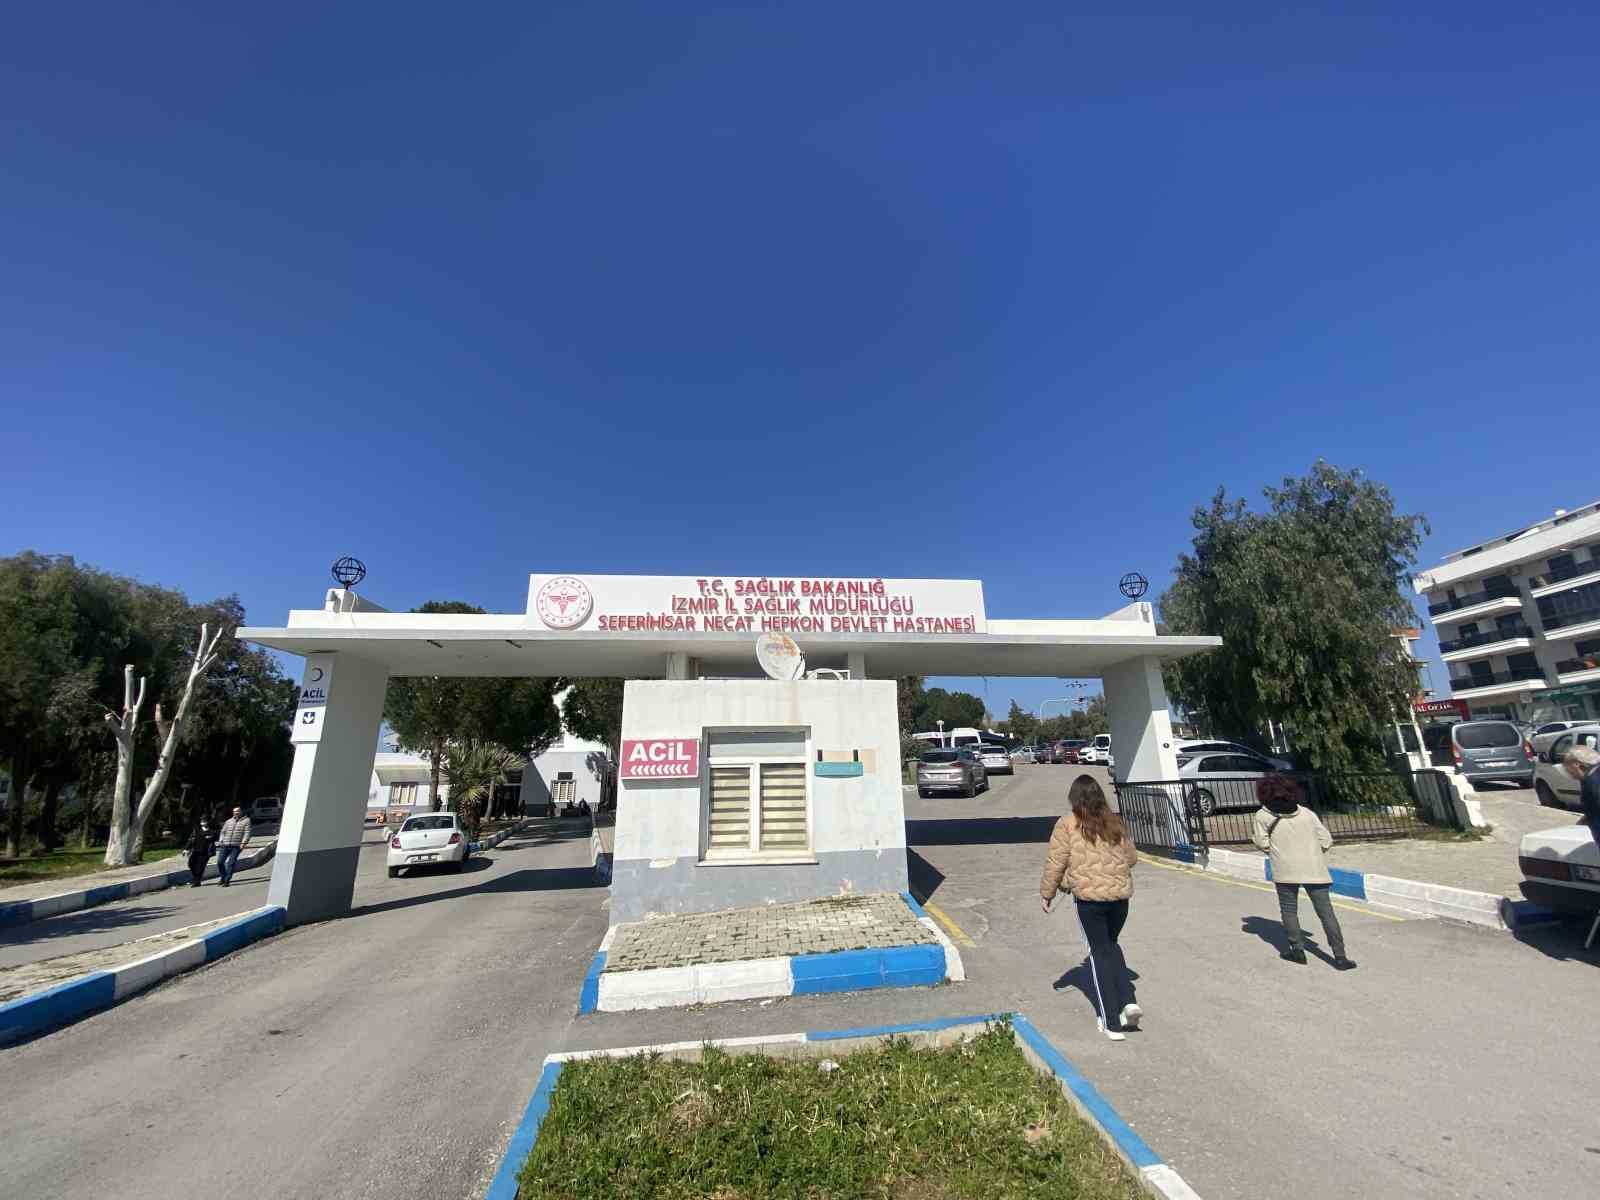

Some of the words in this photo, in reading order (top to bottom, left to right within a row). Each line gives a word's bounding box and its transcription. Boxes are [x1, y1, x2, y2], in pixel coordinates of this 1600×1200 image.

[696, 579, 728, 594] T.C.
[735, 576, 795, 594] SAĞLIK
[801, 577, 885, 595] BAKANLIĞ
[672, 595, 718, 613] İZMİR
[744, 594, 801, 613] SAĞLIK
[809, 595, 914, 614] MÜDÜRLÜĞÜ
[598, 612, 696, 631] SEFERİHİSAR
[704, 615, 754, 632] NECAT
[761, 616, 824, 632] HEPKON
[831, 616, 888, 632] DEVLET
[893, 615, 976, 633] HASTANESİ
